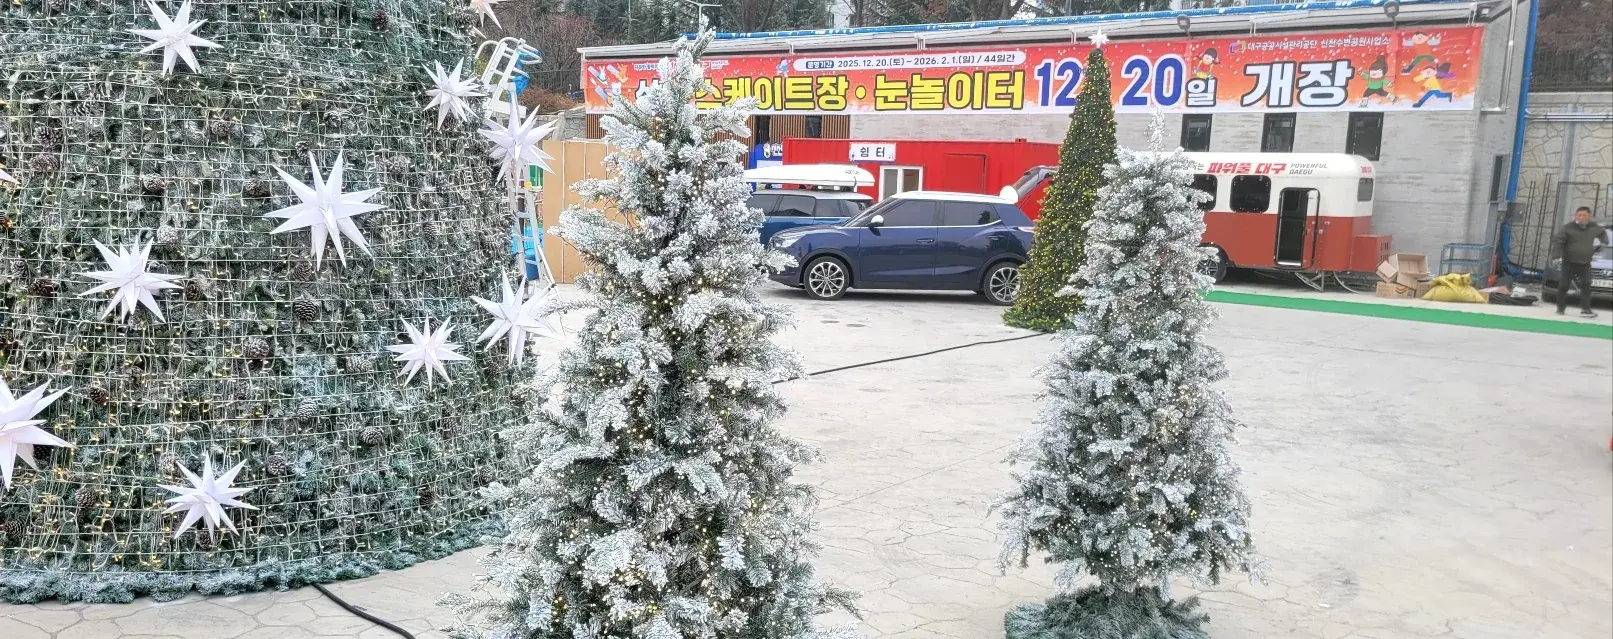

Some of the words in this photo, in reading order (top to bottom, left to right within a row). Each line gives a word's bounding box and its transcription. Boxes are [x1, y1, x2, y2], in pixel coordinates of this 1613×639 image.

[1247, 40, 1318, 51] 대구공공시설관리공단
[807, 61, 833, 69] 운영기간
[838, 60, 861, 68] 2025.
[863, 59, 873, 67] 12.
[914, 57, 939, 65] 2026.
[941, 56, 949, 65] 2.
[984, 54, 1015, 63] 44일간
[695, 74, 849, 111] 스케이트장
[874, 69, 1026, 111] 눈놀이터
[1241, 59, 1355, 108] 개장
[1207, 162, 1252, 174] 파워풀
[1254, 162, 1288, 174] 대구
